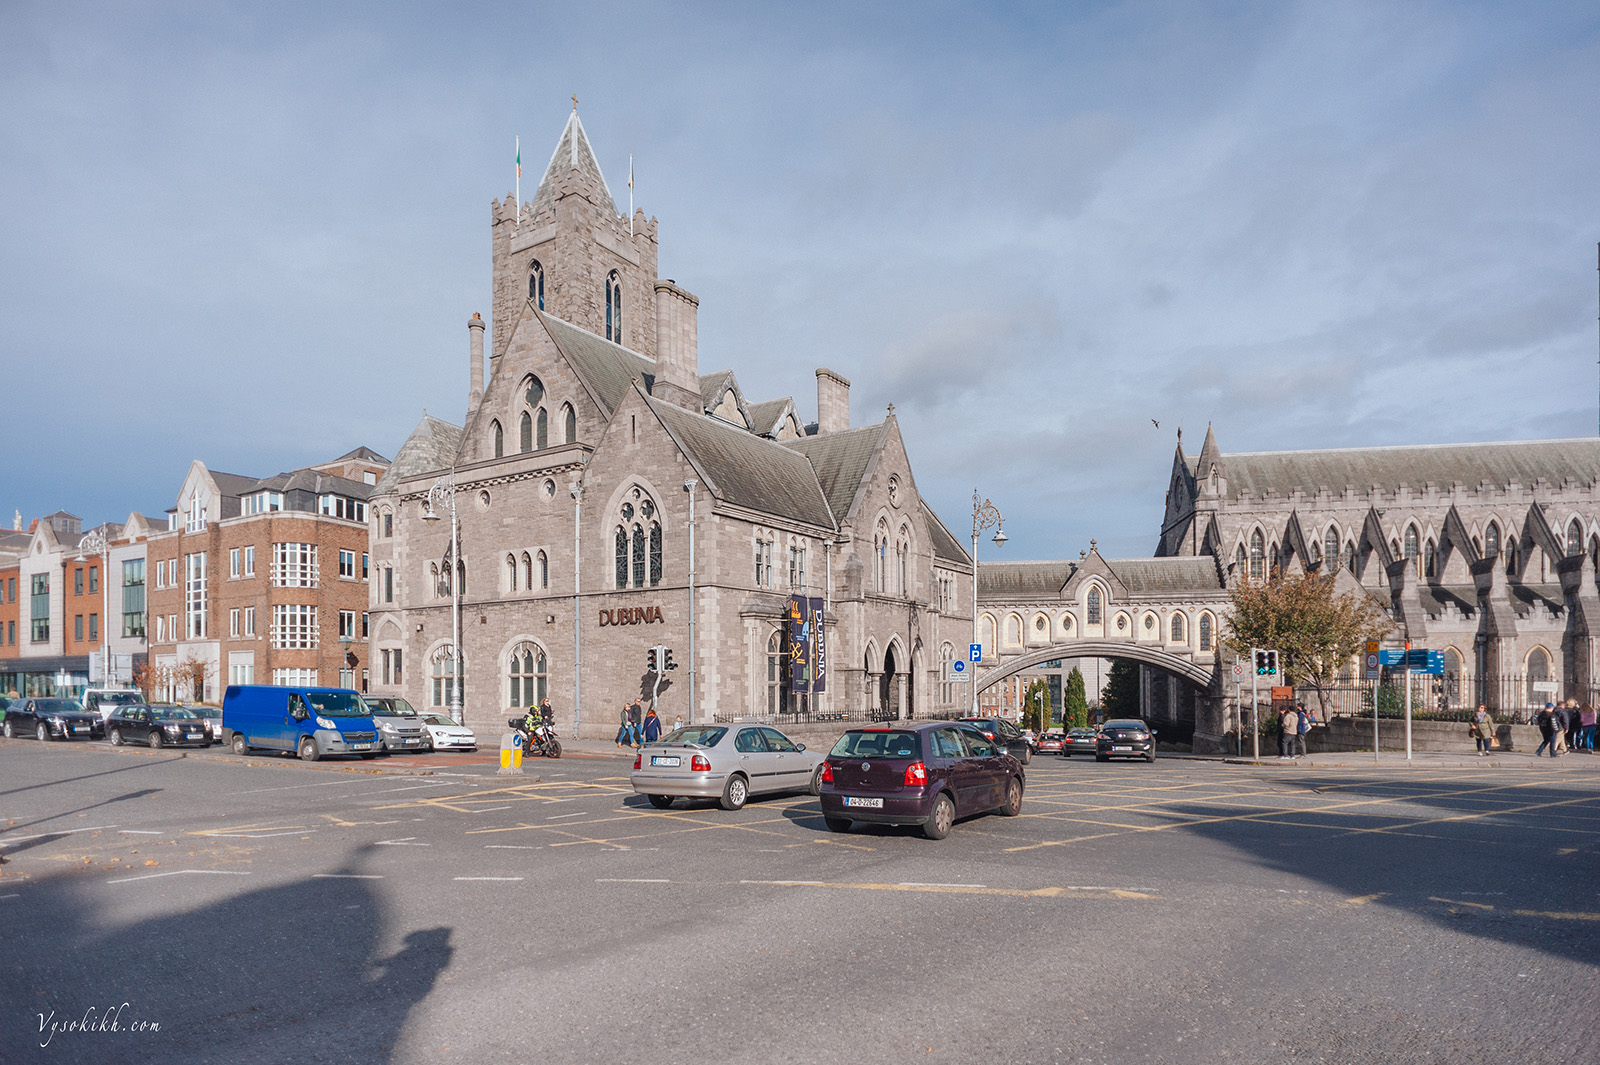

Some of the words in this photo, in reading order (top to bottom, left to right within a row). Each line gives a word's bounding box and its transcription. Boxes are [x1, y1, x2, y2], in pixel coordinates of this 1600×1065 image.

[599, 606, 665, 627] DUBLINIA
[815, 609, 825, 679] DUBLINIA
[971, 650, 980, 661] P
